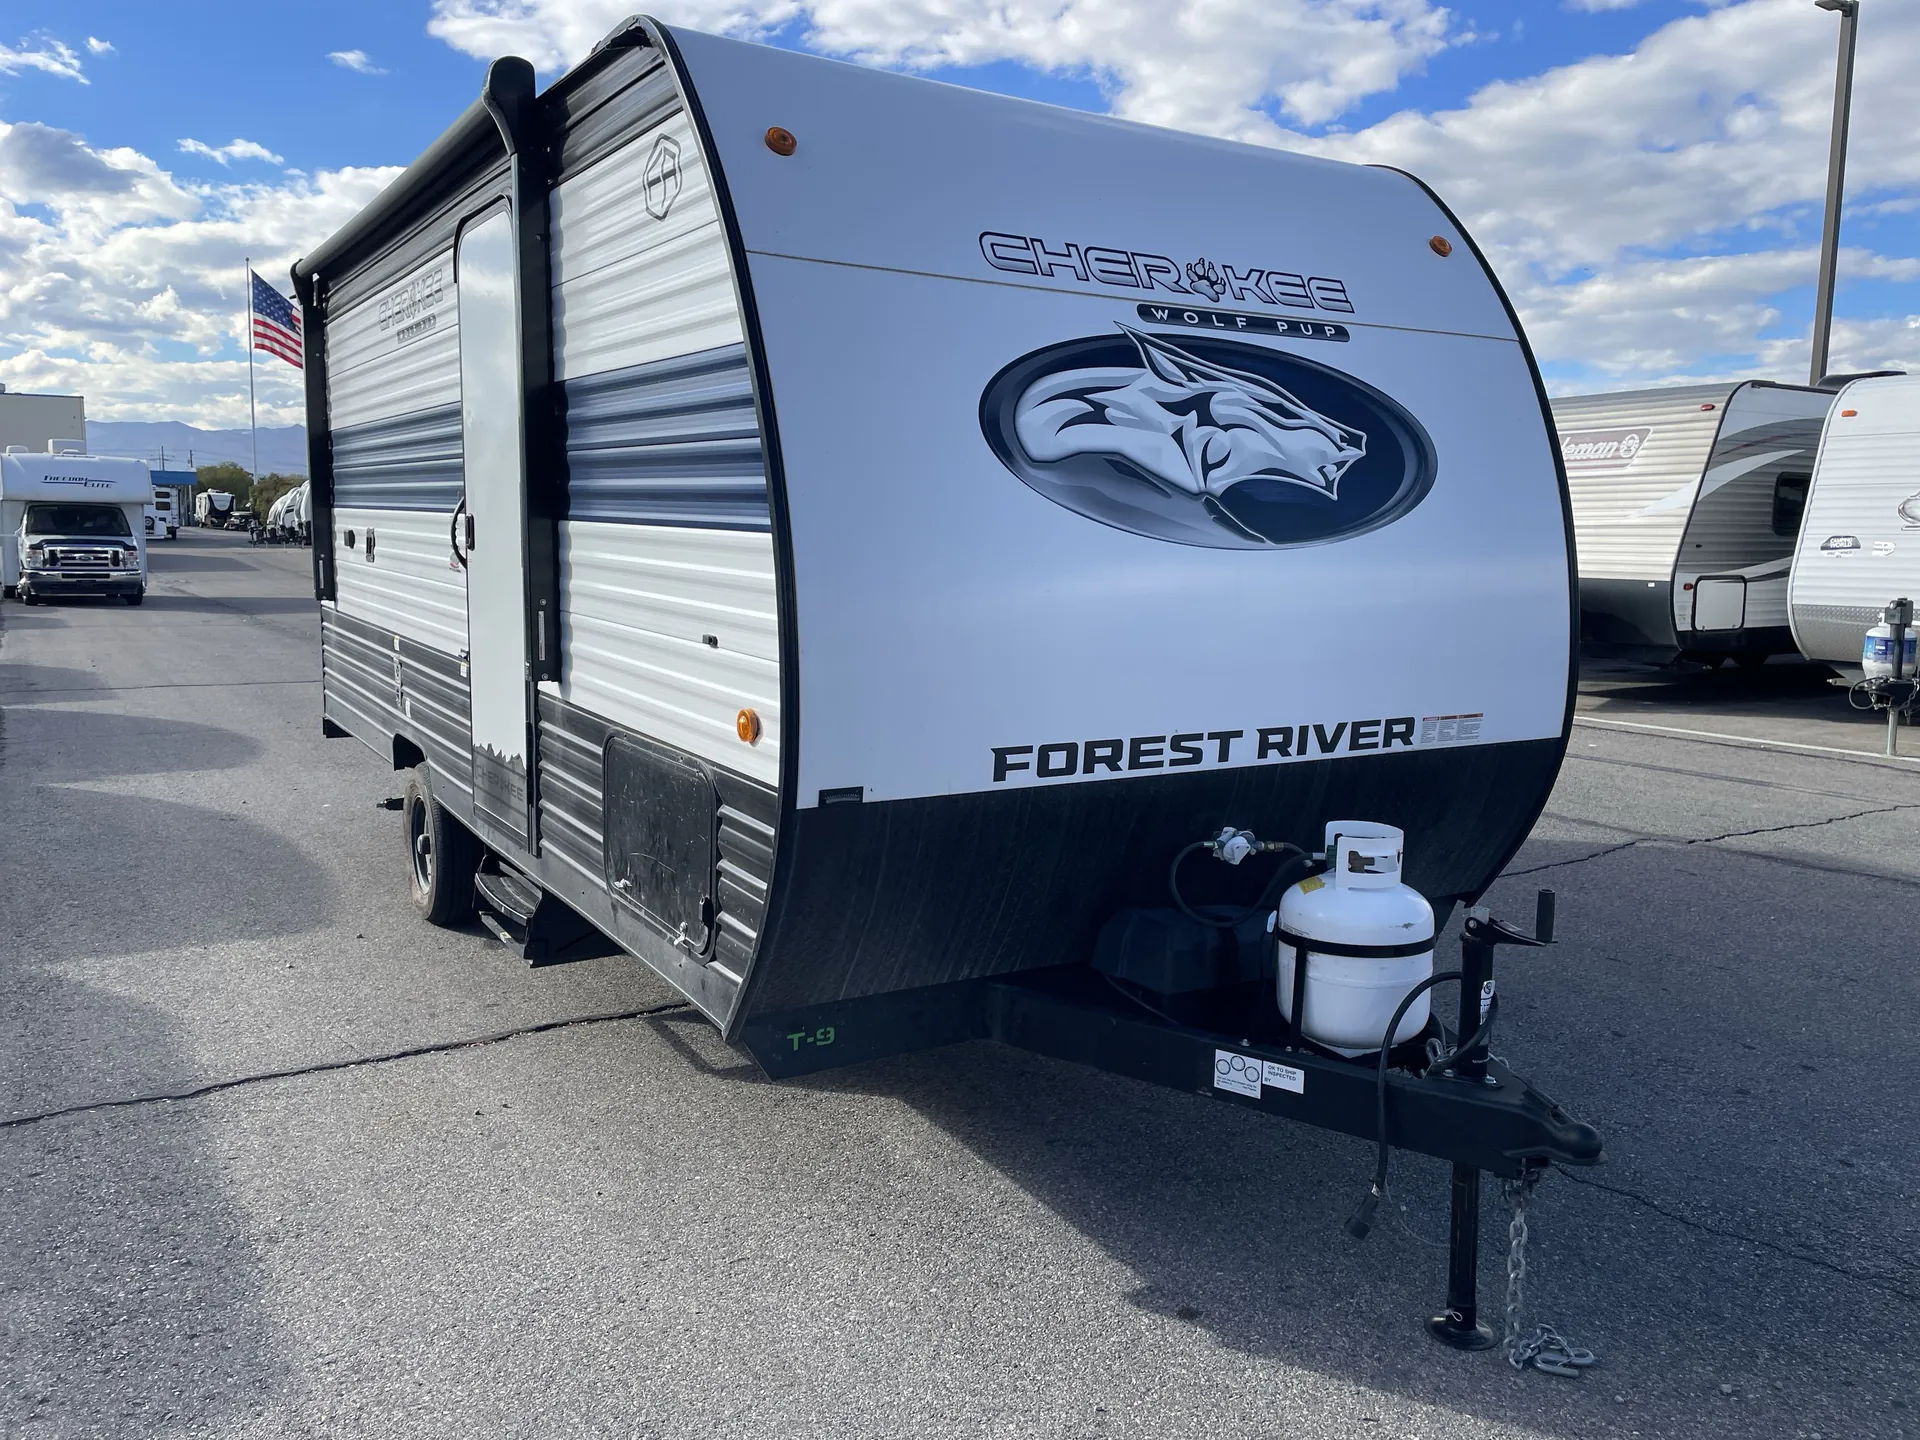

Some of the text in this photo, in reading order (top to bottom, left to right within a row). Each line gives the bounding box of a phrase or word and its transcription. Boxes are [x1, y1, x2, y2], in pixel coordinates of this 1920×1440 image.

[1151, 308, 1336, 337] WOLF PUP
[990, 729, 1244, 783] FOREST
[1256, 716, 1416, 760] RIVER
[1267, 1070, 1297, 1081] INSPECTED
